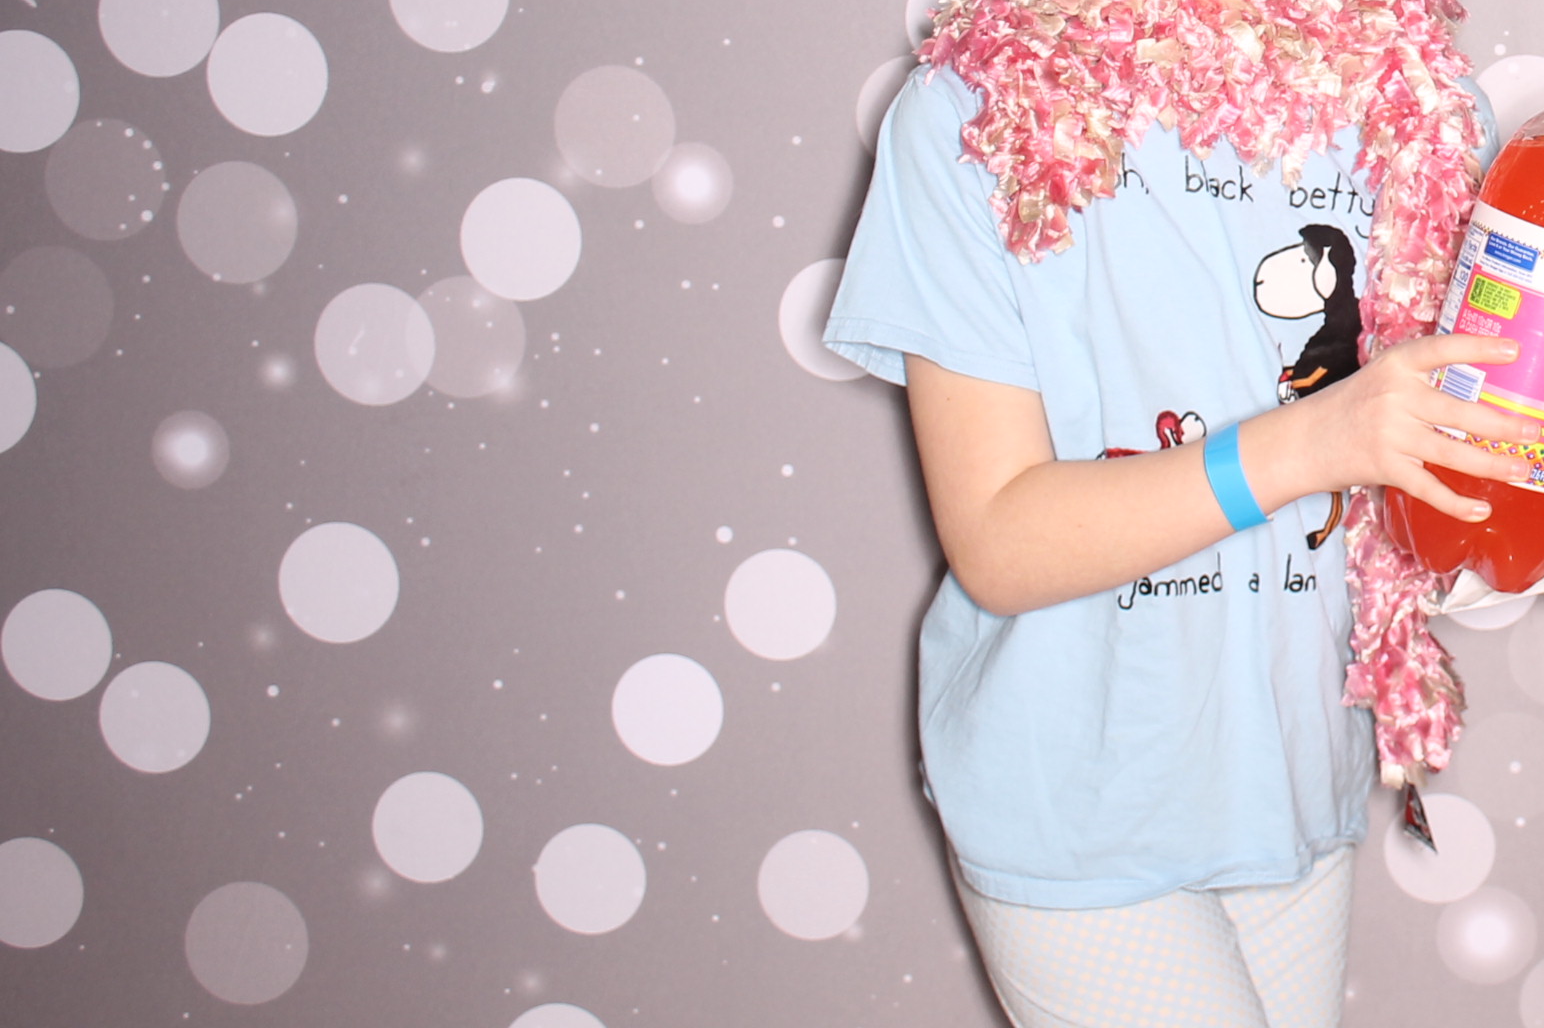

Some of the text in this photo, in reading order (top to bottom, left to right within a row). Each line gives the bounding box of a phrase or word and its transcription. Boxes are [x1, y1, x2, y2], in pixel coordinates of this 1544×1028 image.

[1184, 154, 1254, 203] black
[1288, 171, 1376, 239] betty
[1117, 551, 1224, 610] jammed
[1248, 572, 1260, 593] a
